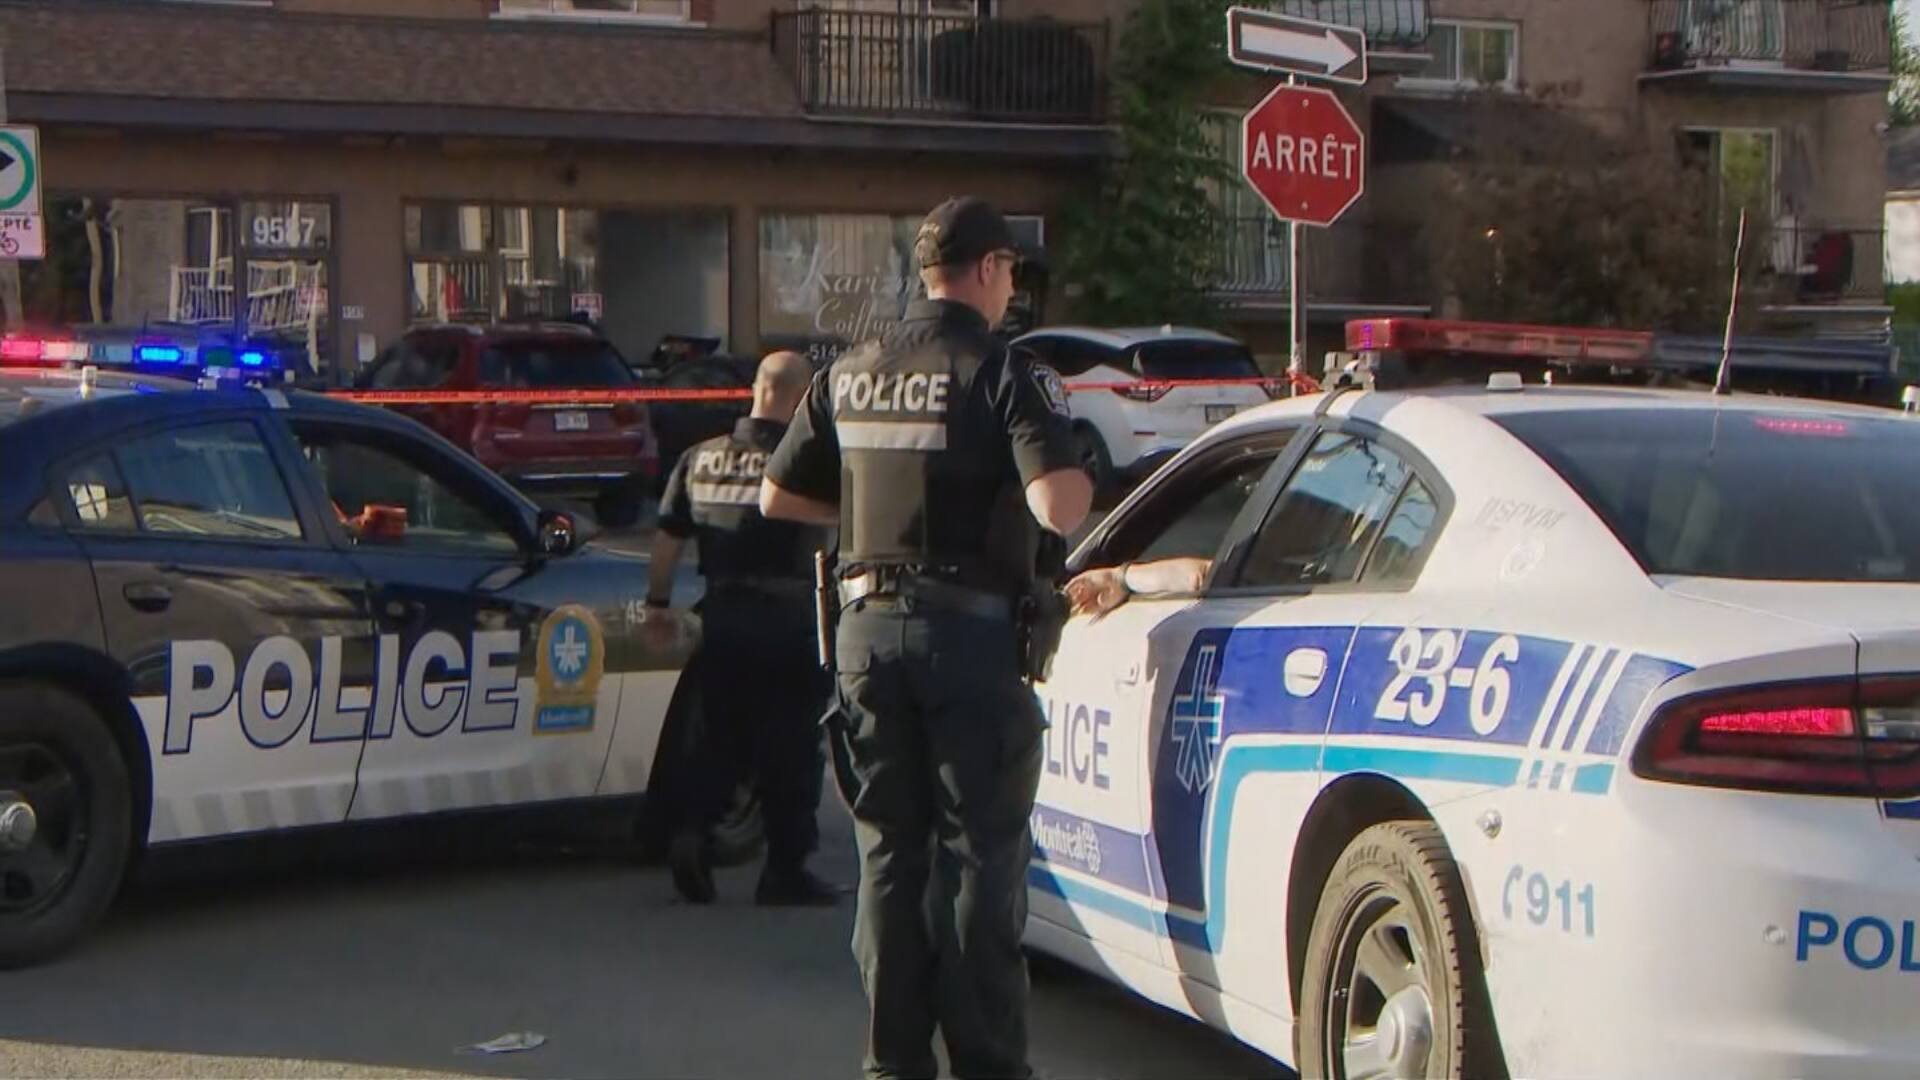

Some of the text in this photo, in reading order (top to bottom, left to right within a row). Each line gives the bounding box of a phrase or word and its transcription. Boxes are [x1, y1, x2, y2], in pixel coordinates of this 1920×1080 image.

[1252, 131, 1357, 180] ARRÊT
[0, 217, 32, 231] PTÉ
[834, 371, 950, 412] POLICE
[162, 630, 521, 756] POLICE
[1374, 627, 1520, 736] 23-6
[1046, 698, 1112, 791] LICE
[1526, 872, 1596, 938] 911
[1796, 911, 1920, 972] POL
